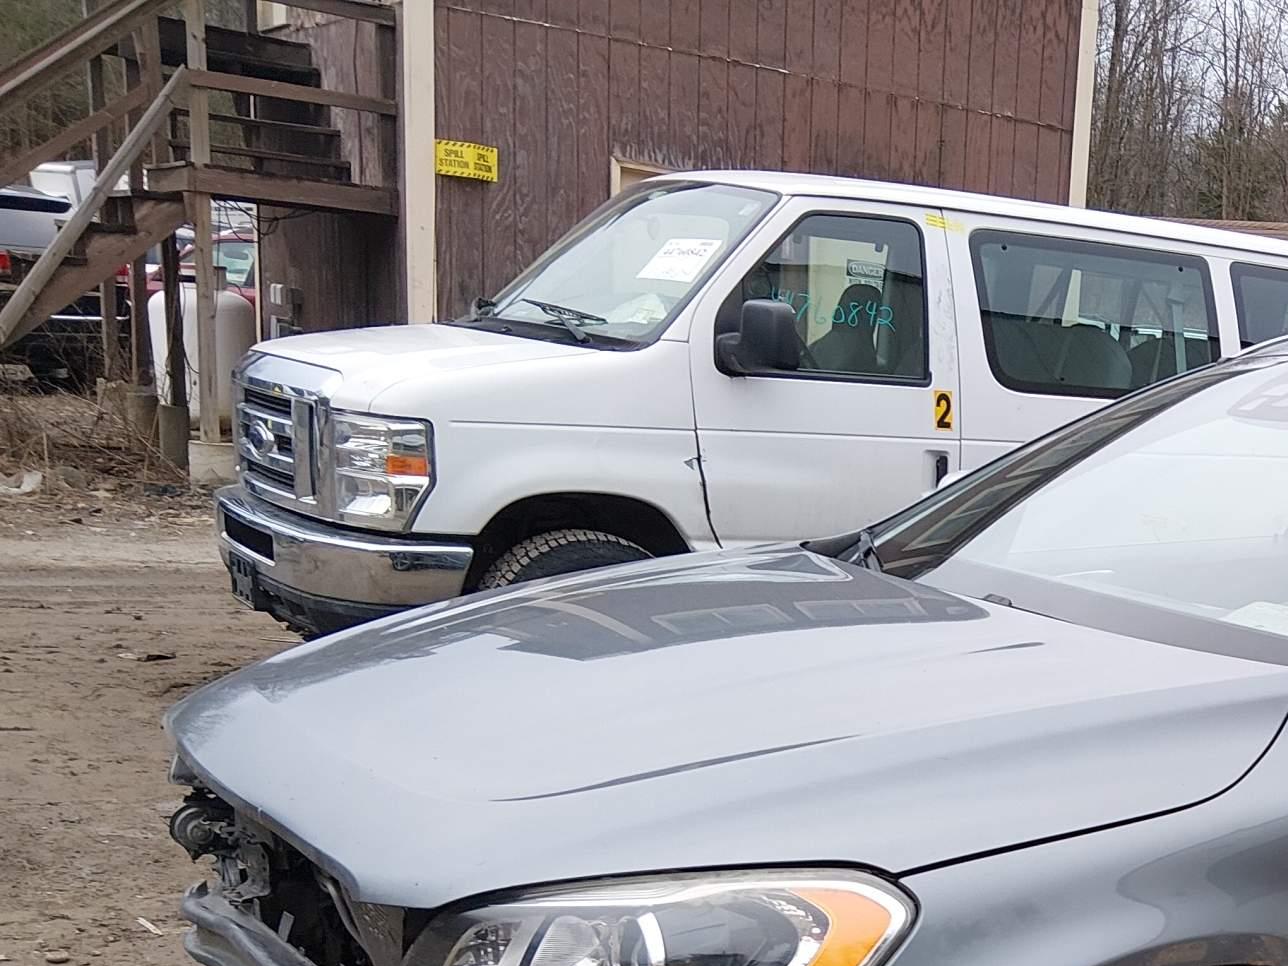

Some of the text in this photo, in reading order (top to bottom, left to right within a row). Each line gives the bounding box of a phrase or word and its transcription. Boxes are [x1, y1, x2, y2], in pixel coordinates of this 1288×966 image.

[443, 148, 464, 159] SPILL
[438, 158, 469, 169] STATION
[936, 393, 951, 428] 2
